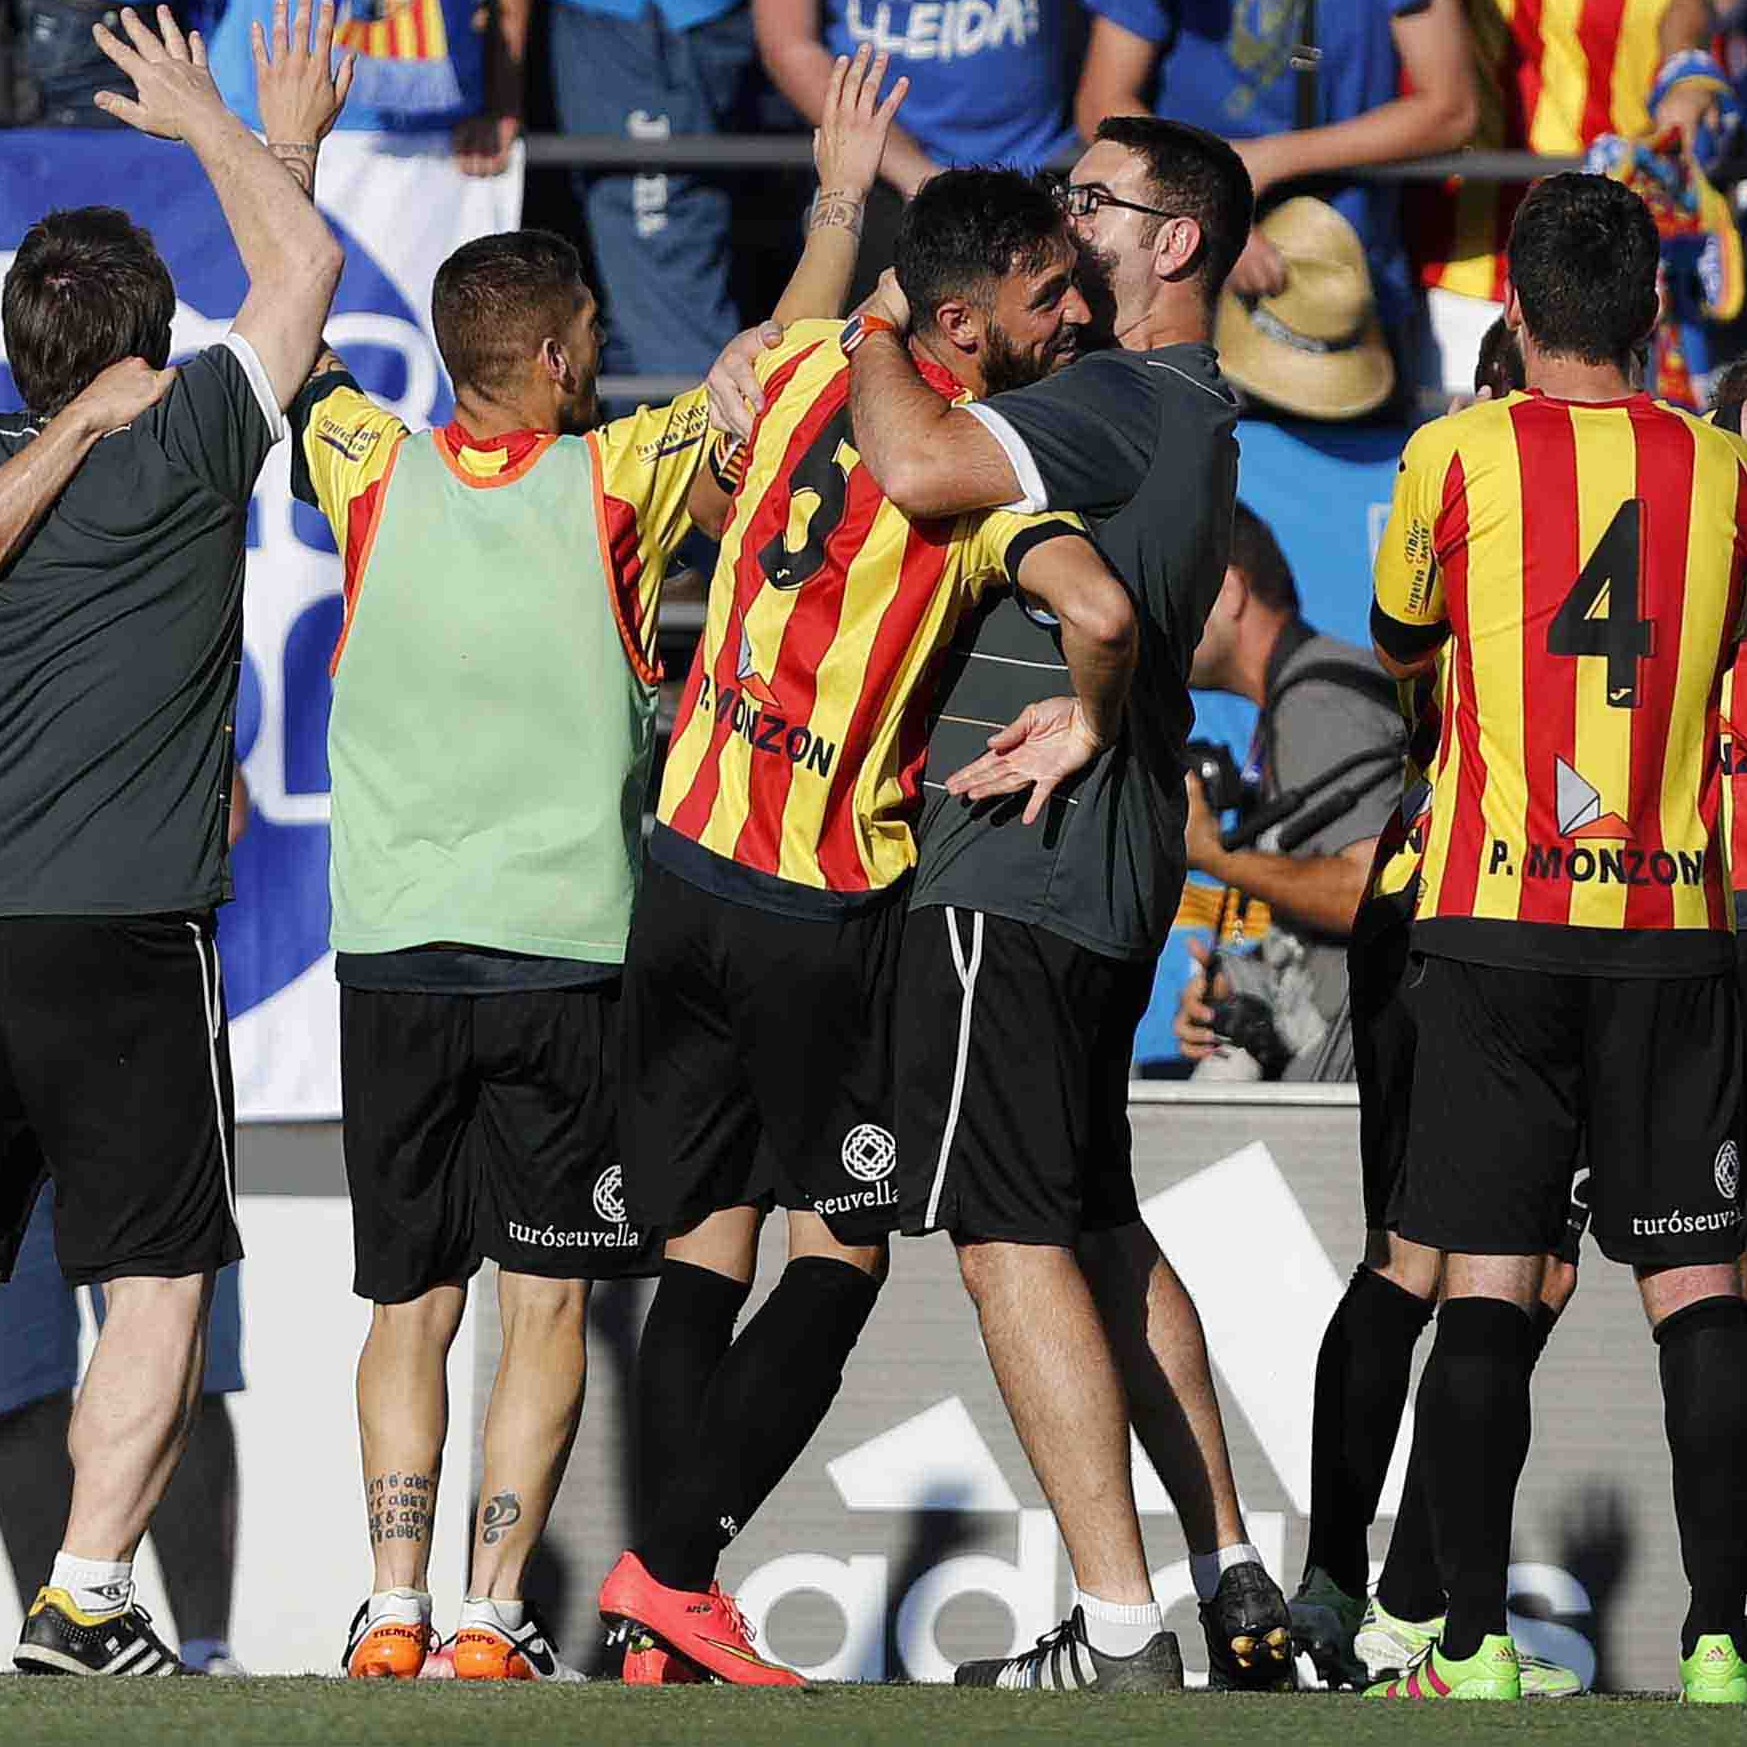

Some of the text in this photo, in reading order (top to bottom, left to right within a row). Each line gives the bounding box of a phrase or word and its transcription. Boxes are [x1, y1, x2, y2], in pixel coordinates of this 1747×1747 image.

[1547, 498, 1656, 708] 4
[1489, 839, 1705, 886] P. MONZON
[508, 1220, 639, 1248] turóseuvella
